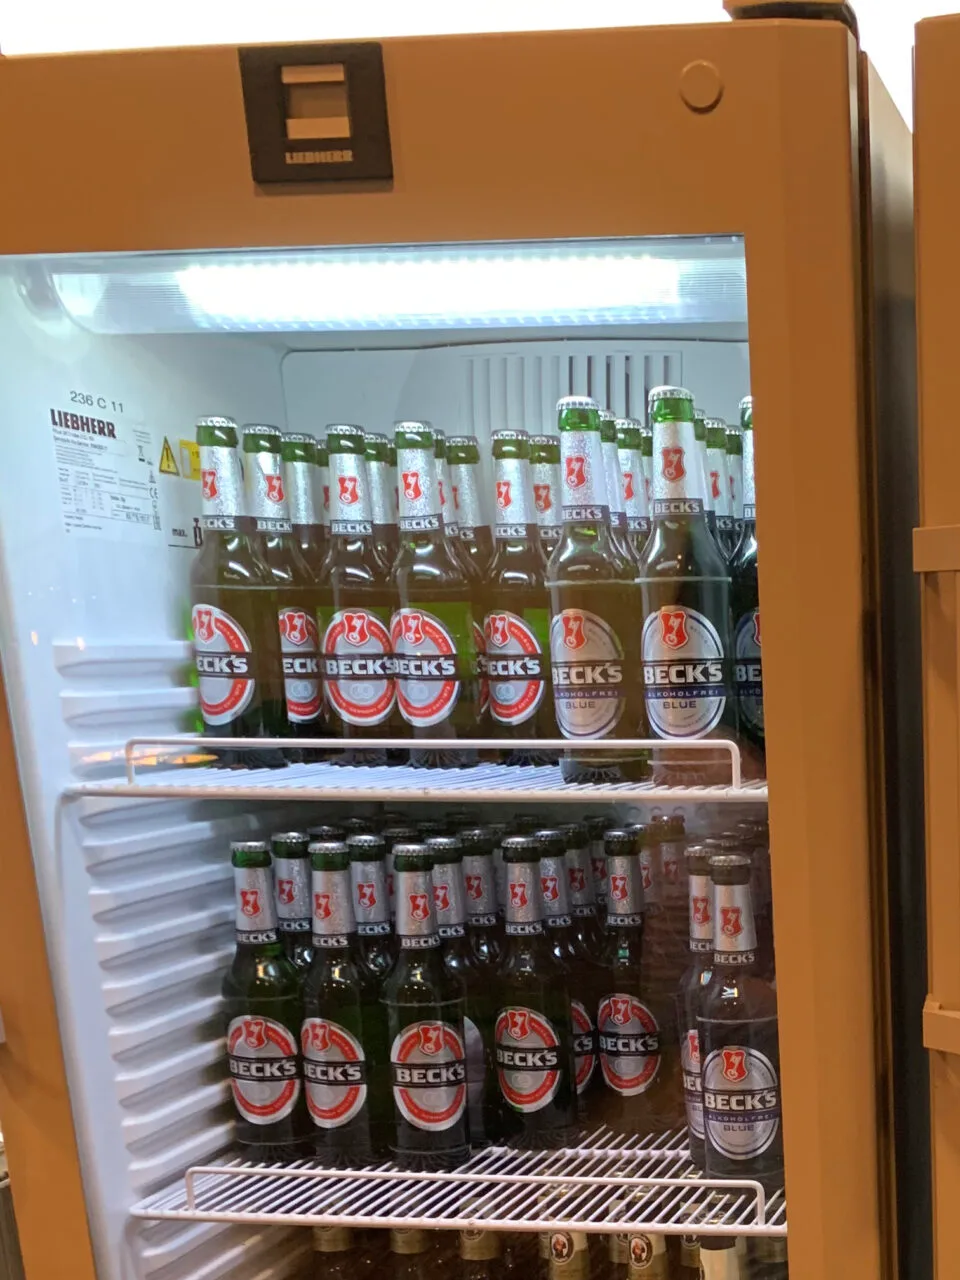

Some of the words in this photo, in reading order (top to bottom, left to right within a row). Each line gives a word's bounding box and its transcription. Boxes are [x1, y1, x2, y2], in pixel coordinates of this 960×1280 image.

[70, 390, 94, 407] 236
[97, 397, 107, 410] C
[111, 401, 124, 413] 11
[50, 408, 117, 439] LIEBHERR
[654, 500, 701, 514] BECK'S
[257, 519, 292, 532] BECK
[332, 521, 373, 535] BECK'S
[197, 654, 249, 673] ECK'S
[326, 656, 394, 675] BECK'S
[488, 655, 541, 676] ECK'S
[552, 660, 623, 684] BECK'S
[643, 659, 723, 684] BECK'S
[565, 699, 596, 710] BLUE
[662, 700, 697, 710] BLUE
[357, 923, 391, 935] ECK'S
[313, 936, 348, 947] ECK'S
[714, 951, 755, 964] BECK'S
[229, 1058, 297, 1078] BECK'S
[396, 1062, 465, 1084] BECK'S
[704, 1089, 777, 1111] BECK'S
